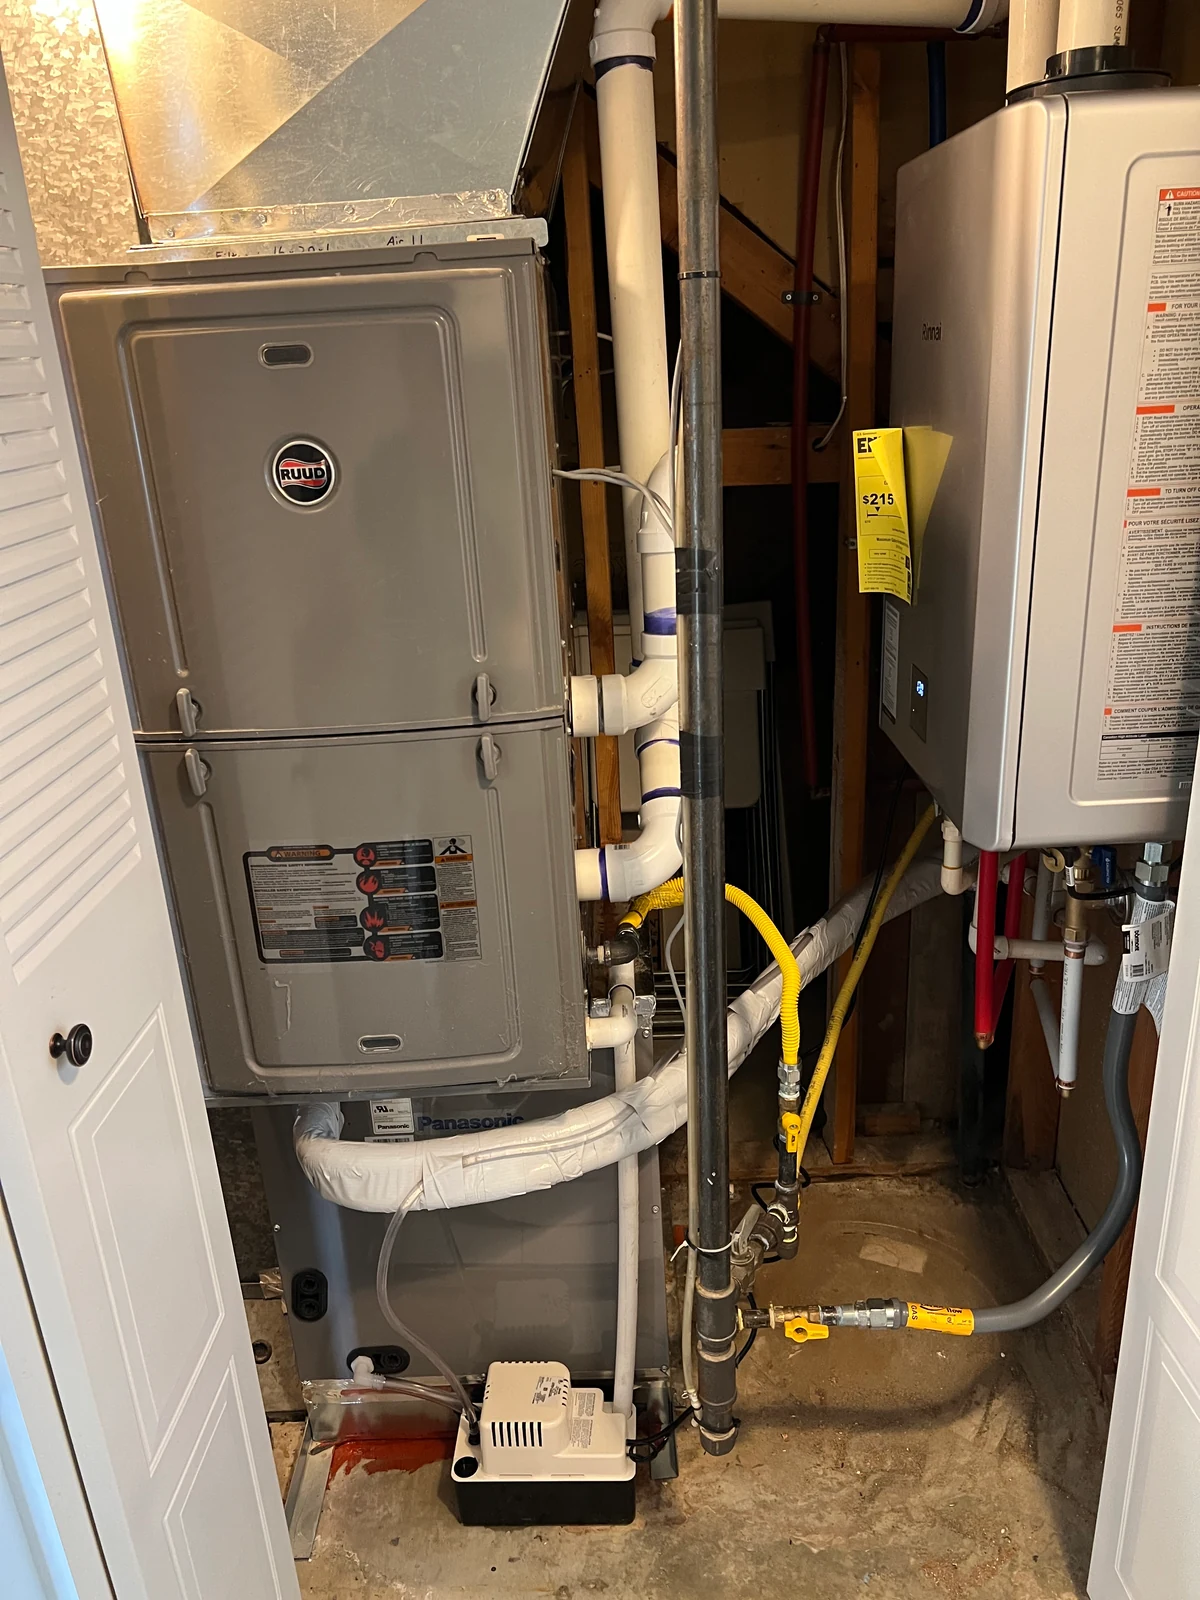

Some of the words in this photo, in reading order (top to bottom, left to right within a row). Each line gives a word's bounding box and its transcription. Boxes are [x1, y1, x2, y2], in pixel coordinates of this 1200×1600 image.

[922, 322, 942, 340] Rinnai
[280, 468, 326, 480] RUUD
[862, 493, 894, 506] $215
[417, 1112, 524, 1132] Panasonic
[910, 1304, 918, 1320] GAS
